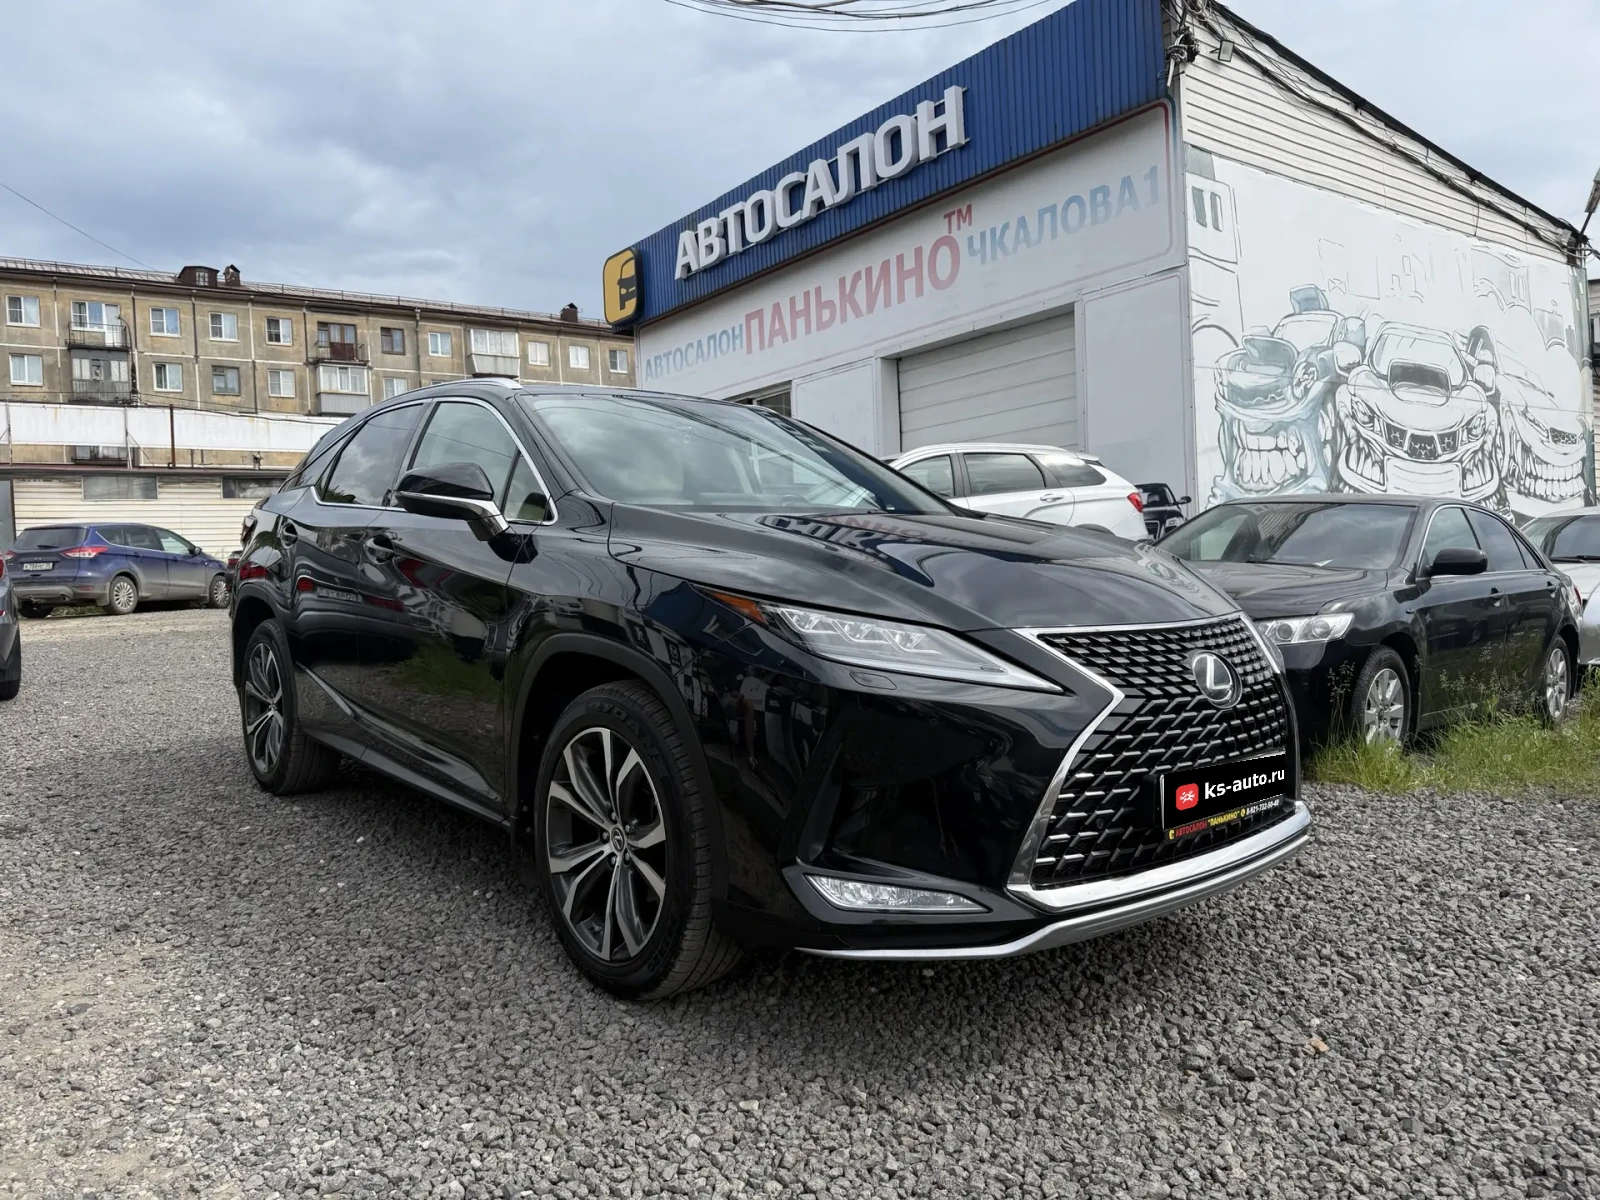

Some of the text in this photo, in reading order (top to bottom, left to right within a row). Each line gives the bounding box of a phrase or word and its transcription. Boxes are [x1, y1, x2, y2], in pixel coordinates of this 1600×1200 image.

[675, 85, 967, 280] АВТОСАЛОН
[644, 323, 744, 382] АВТОСАЛОН
[744, 235, 961, 356] ПАНЬКИНО
[1175, 819, 1207, 838] АВТОСАЛОН
